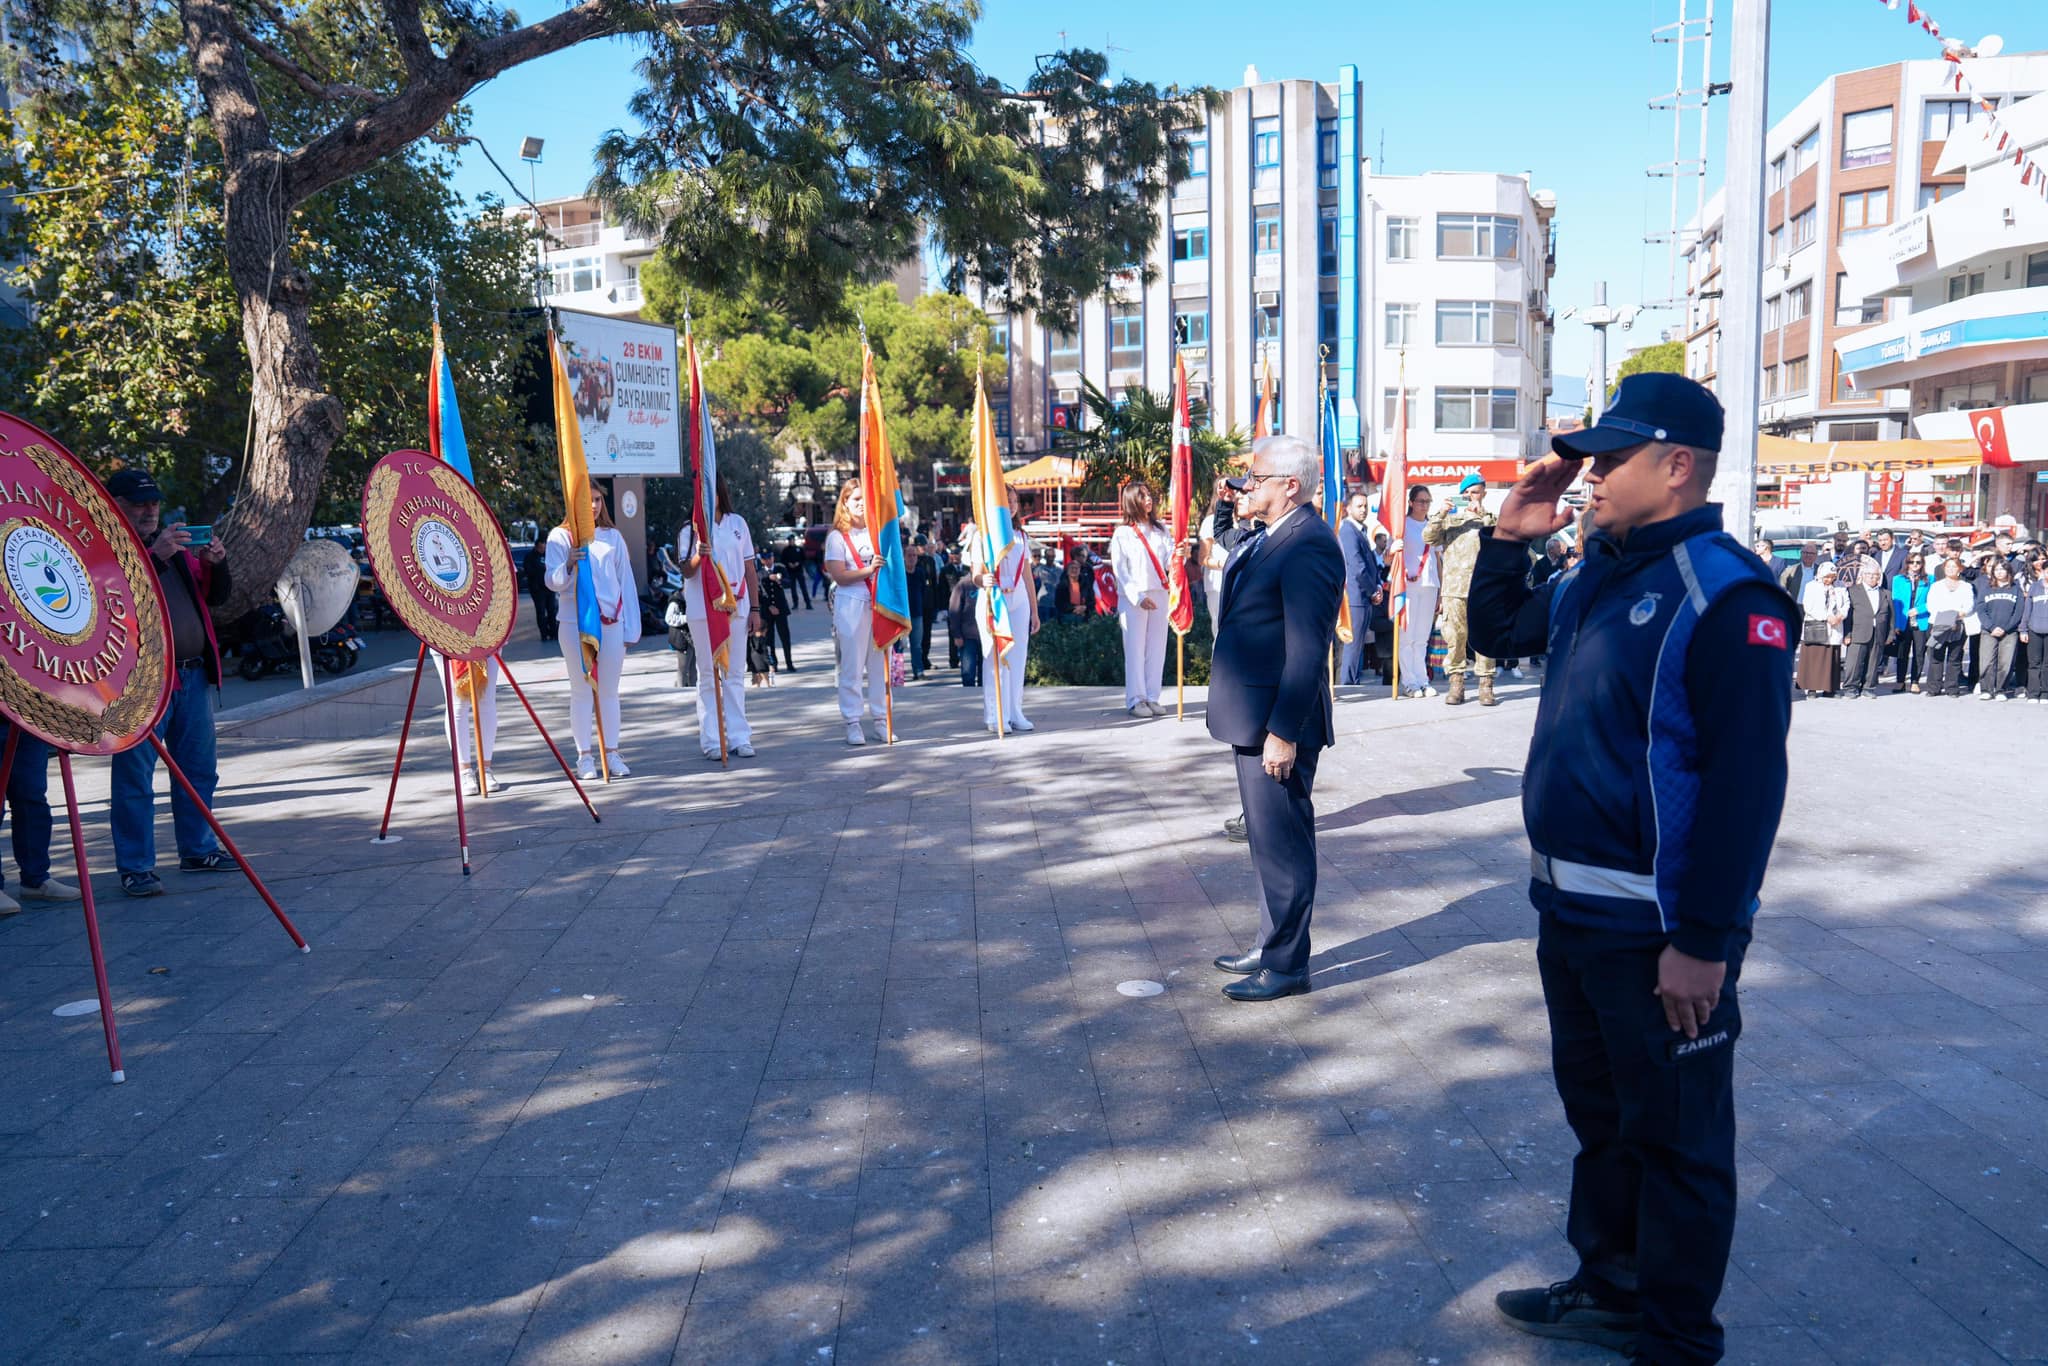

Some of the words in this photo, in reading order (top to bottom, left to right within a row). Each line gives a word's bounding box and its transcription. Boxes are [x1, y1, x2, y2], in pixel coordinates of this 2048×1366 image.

[623, 341, 635, 357] 29
[638, 341, 662, 361] EKİM
[615, 360, 670, 387] CUMHURİYET
[617, 388, 671, 411] BAYRAMIMIZ
[1408, 465, 1482, 477] AKBANK
[0, 586, 128, 684] AYMAKAMLIĞI
[1677, 1031, 1728, 1054] ZABITA
